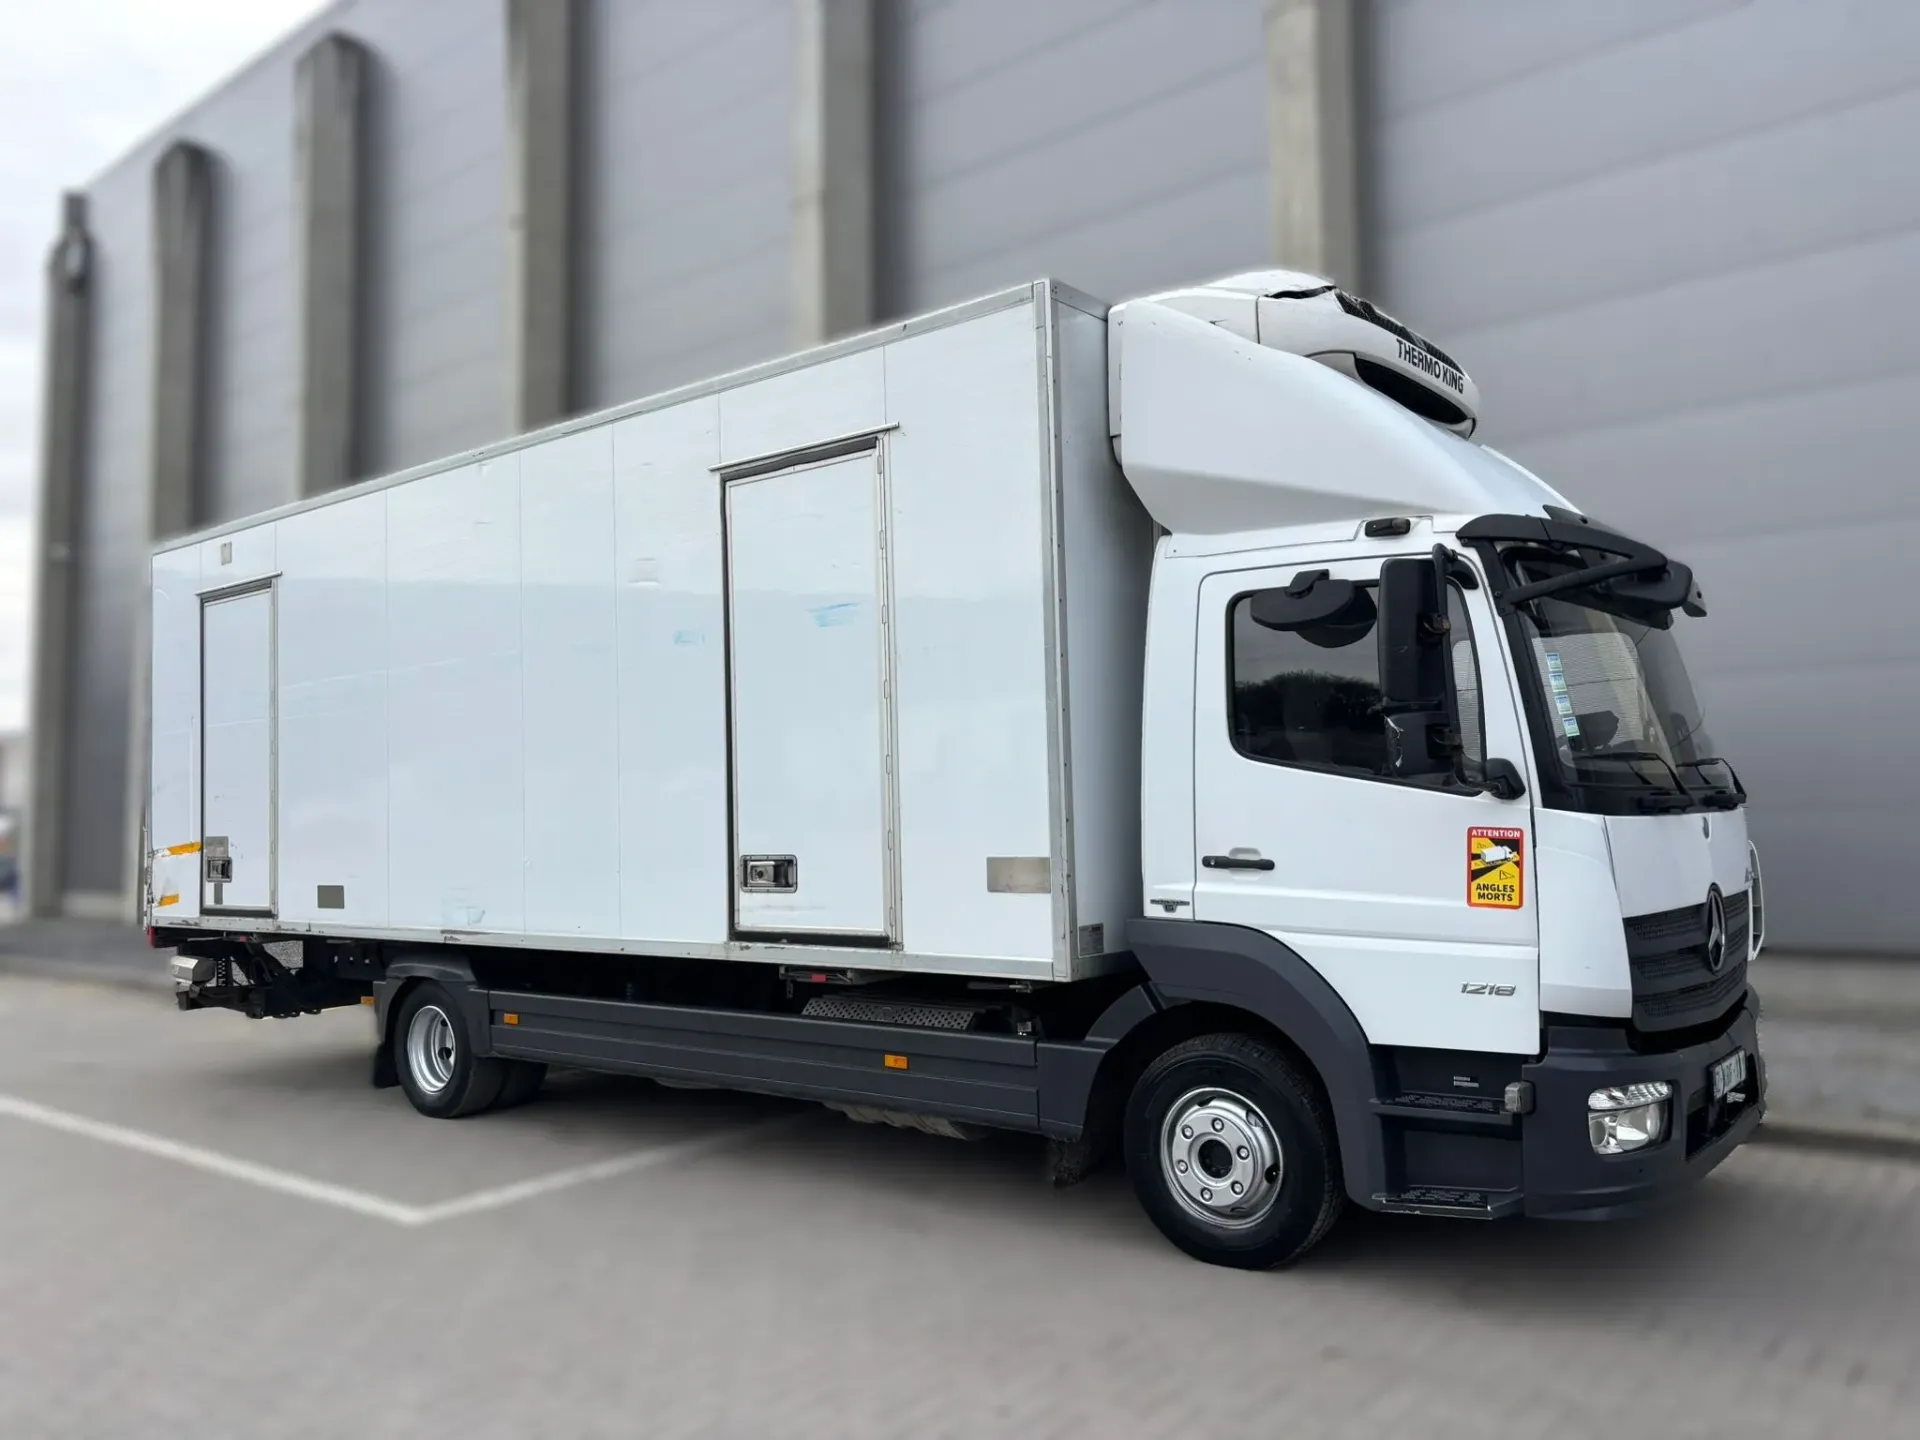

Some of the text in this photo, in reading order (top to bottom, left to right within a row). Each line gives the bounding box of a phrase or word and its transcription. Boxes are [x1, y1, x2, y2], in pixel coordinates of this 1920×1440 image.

[1396, 338, 1464, 394] THERMO KING
[1471, 829, 1520, 838] ATTENTION
[1476, 883, 1515, 893] ANGLES
[1477, 892, 1513, 902] MORTS
[1461, 982, 1516, 996] 1218
